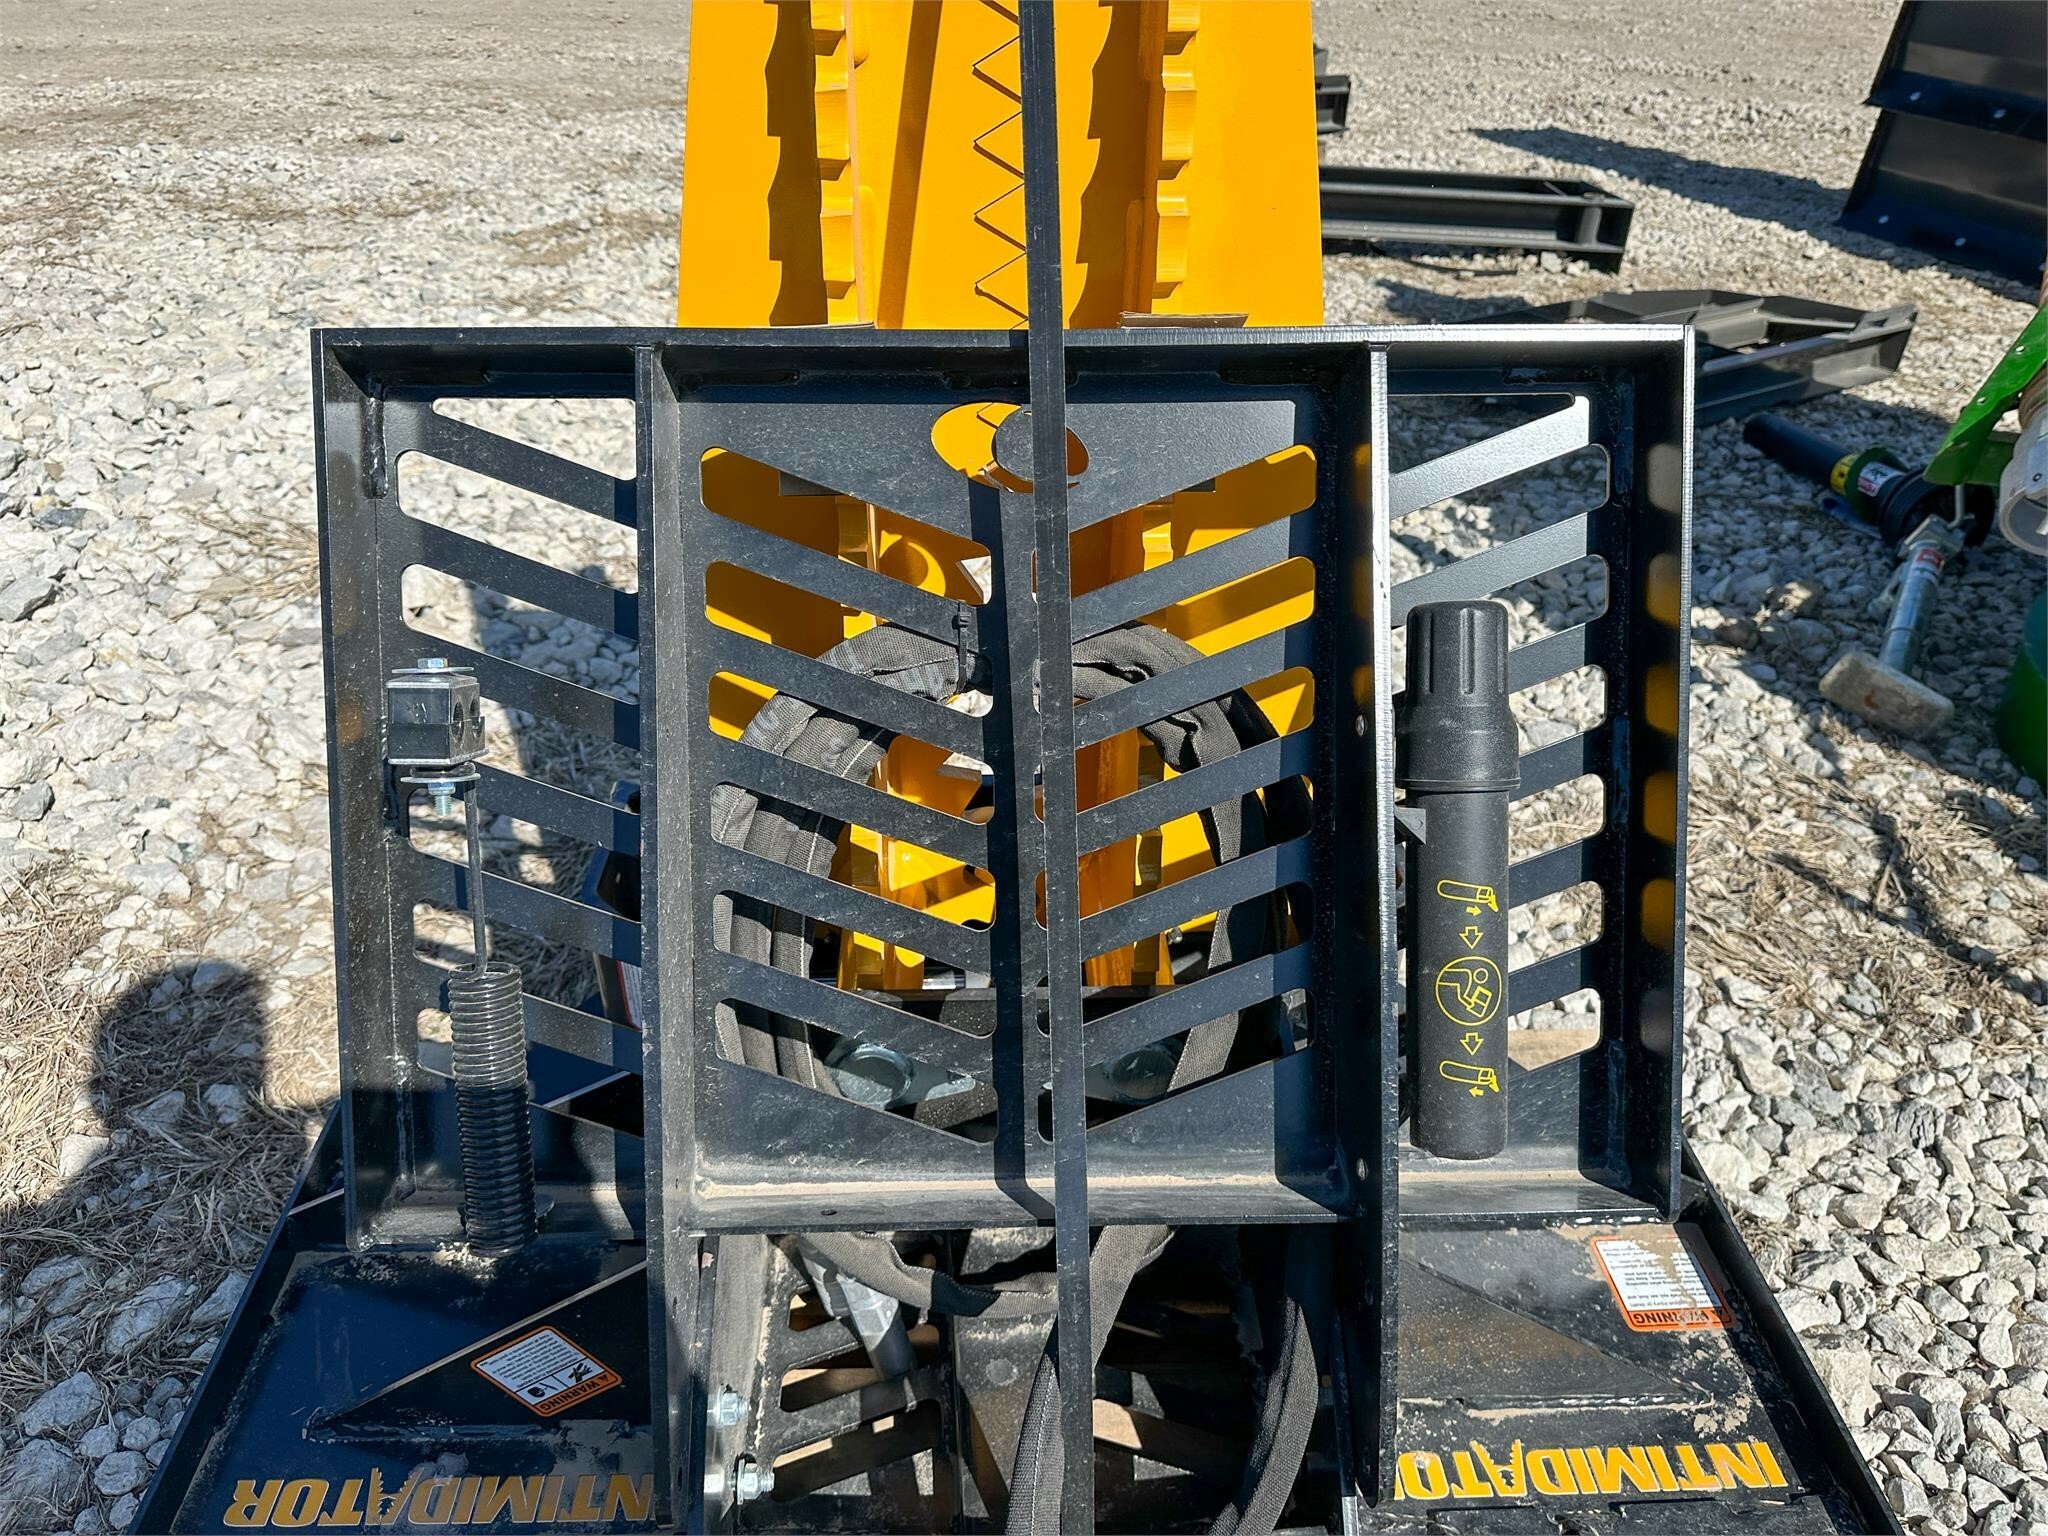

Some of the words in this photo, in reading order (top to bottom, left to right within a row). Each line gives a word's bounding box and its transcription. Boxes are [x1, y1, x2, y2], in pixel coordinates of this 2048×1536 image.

[540, 1380, 601, 1411] WARNING
[223, 1467, 656, 1527] NTIMIDATOR
[1395, 1439, 1789, 1500] INTIMIDATO
